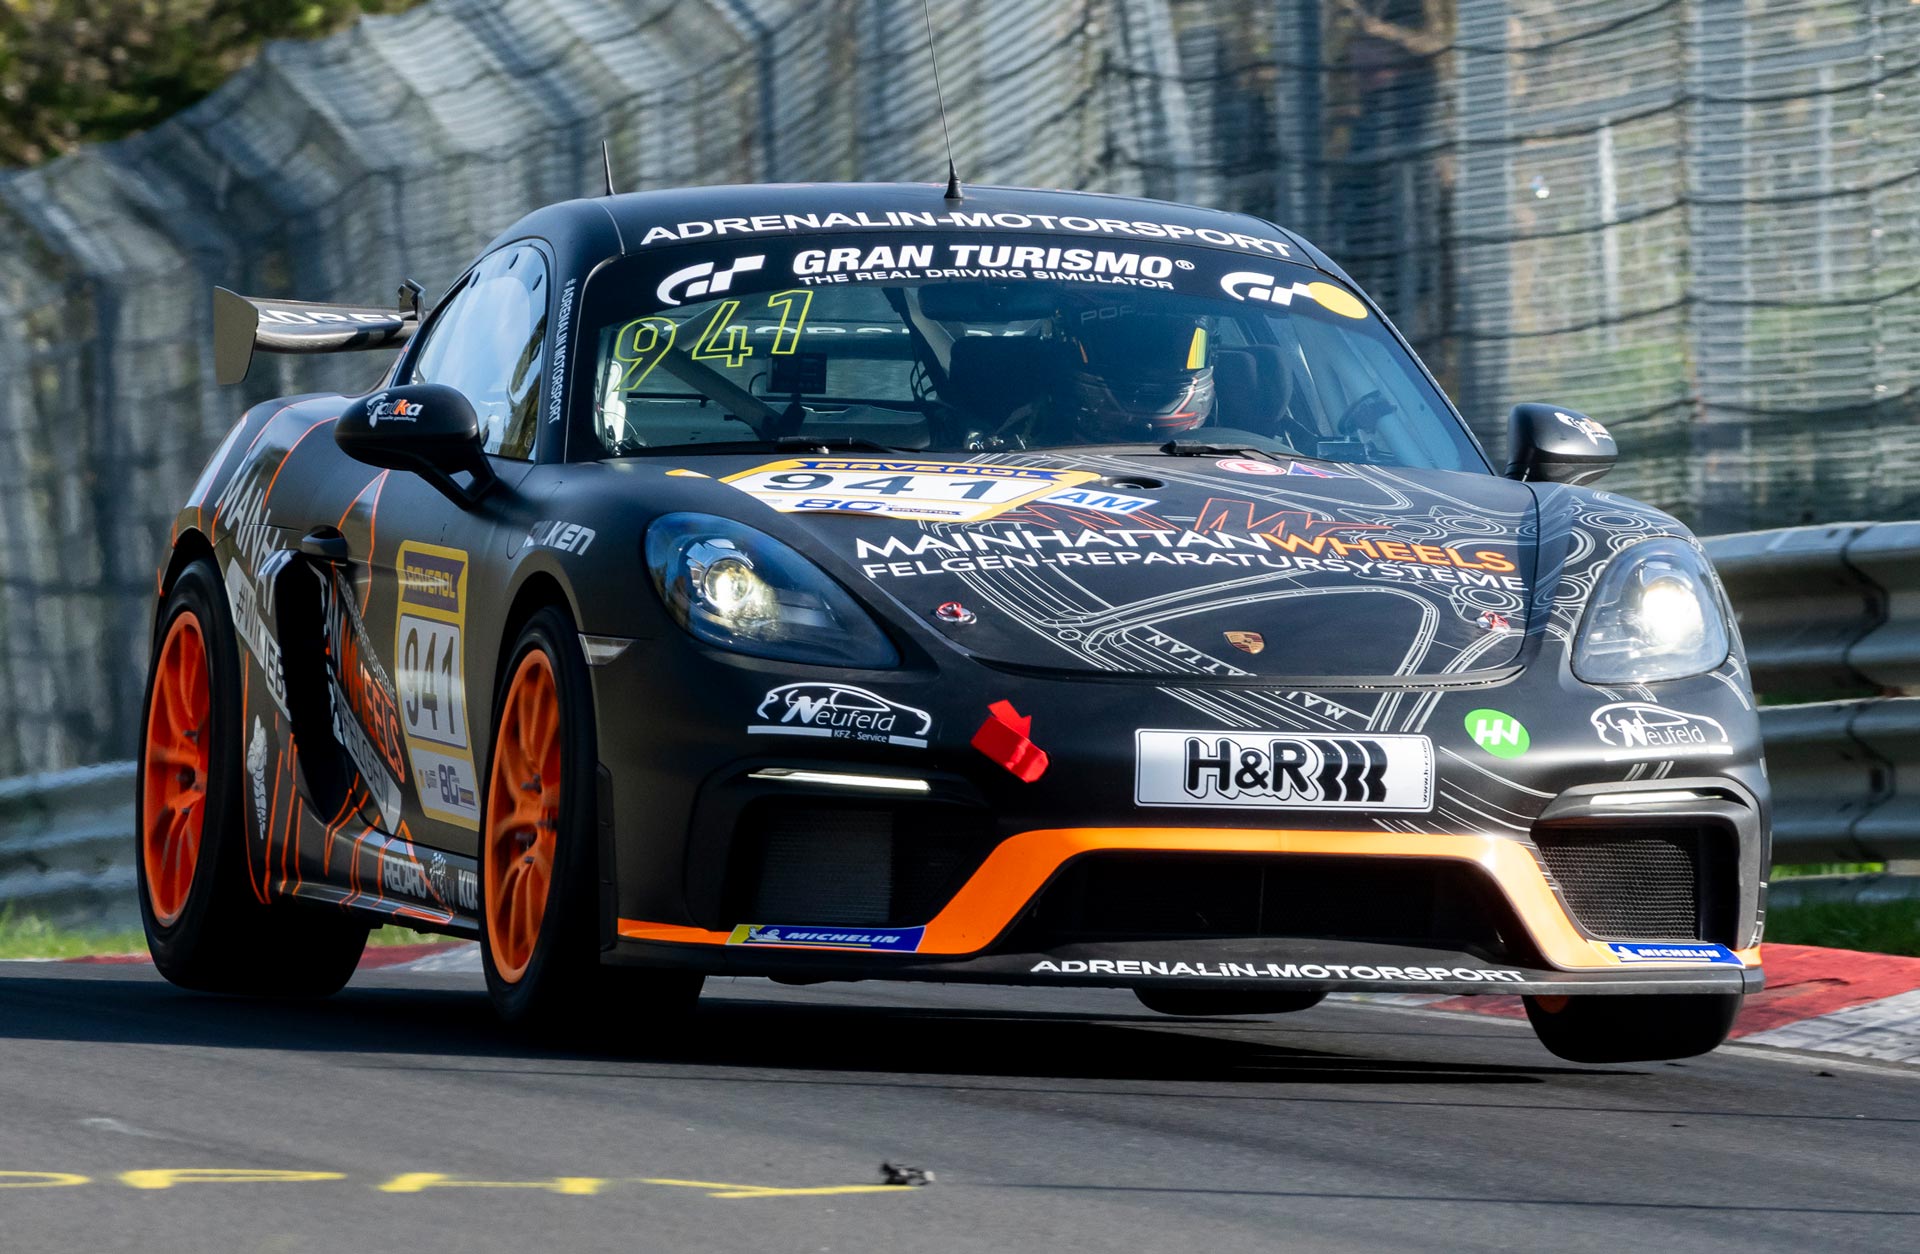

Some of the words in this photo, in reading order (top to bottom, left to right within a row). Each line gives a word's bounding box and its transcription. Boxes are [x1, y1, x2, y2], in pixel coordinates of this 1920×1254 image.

[640, 211, 1291, 258] ADRENALIN-MOTORSPORT
[793, 245, 934, 275] GRAN
[799, 273, 849, 286] THE
[855, 270, 920, 281] REAL
[925, 269, 1028, 279] DRIVING
[1034, 271, 1175, 290] SIMULATOR
[612, 289, 814, 393] 941
[817, 460, 1042, 479] RAVENOL
[763, 472, 998, 500] 941
[1050, 490, 1142, 512] AM
[861, 551, 1530, 592] FELGEN-REPARATURSYSTEME
[404, 627, 456, 736] 941
[780, 696, 896, 732] Neufeld
[833, 729, 850, 739] KFZ
[857, 731, 888, 743] Service
[1619, 718, 1706, 747] Neufeld
[1185, 737, 1318, 799] H&R
[785, 932, 901, 944] MICHELIN
[1637, 948, 1721, 958] MICHELIN
